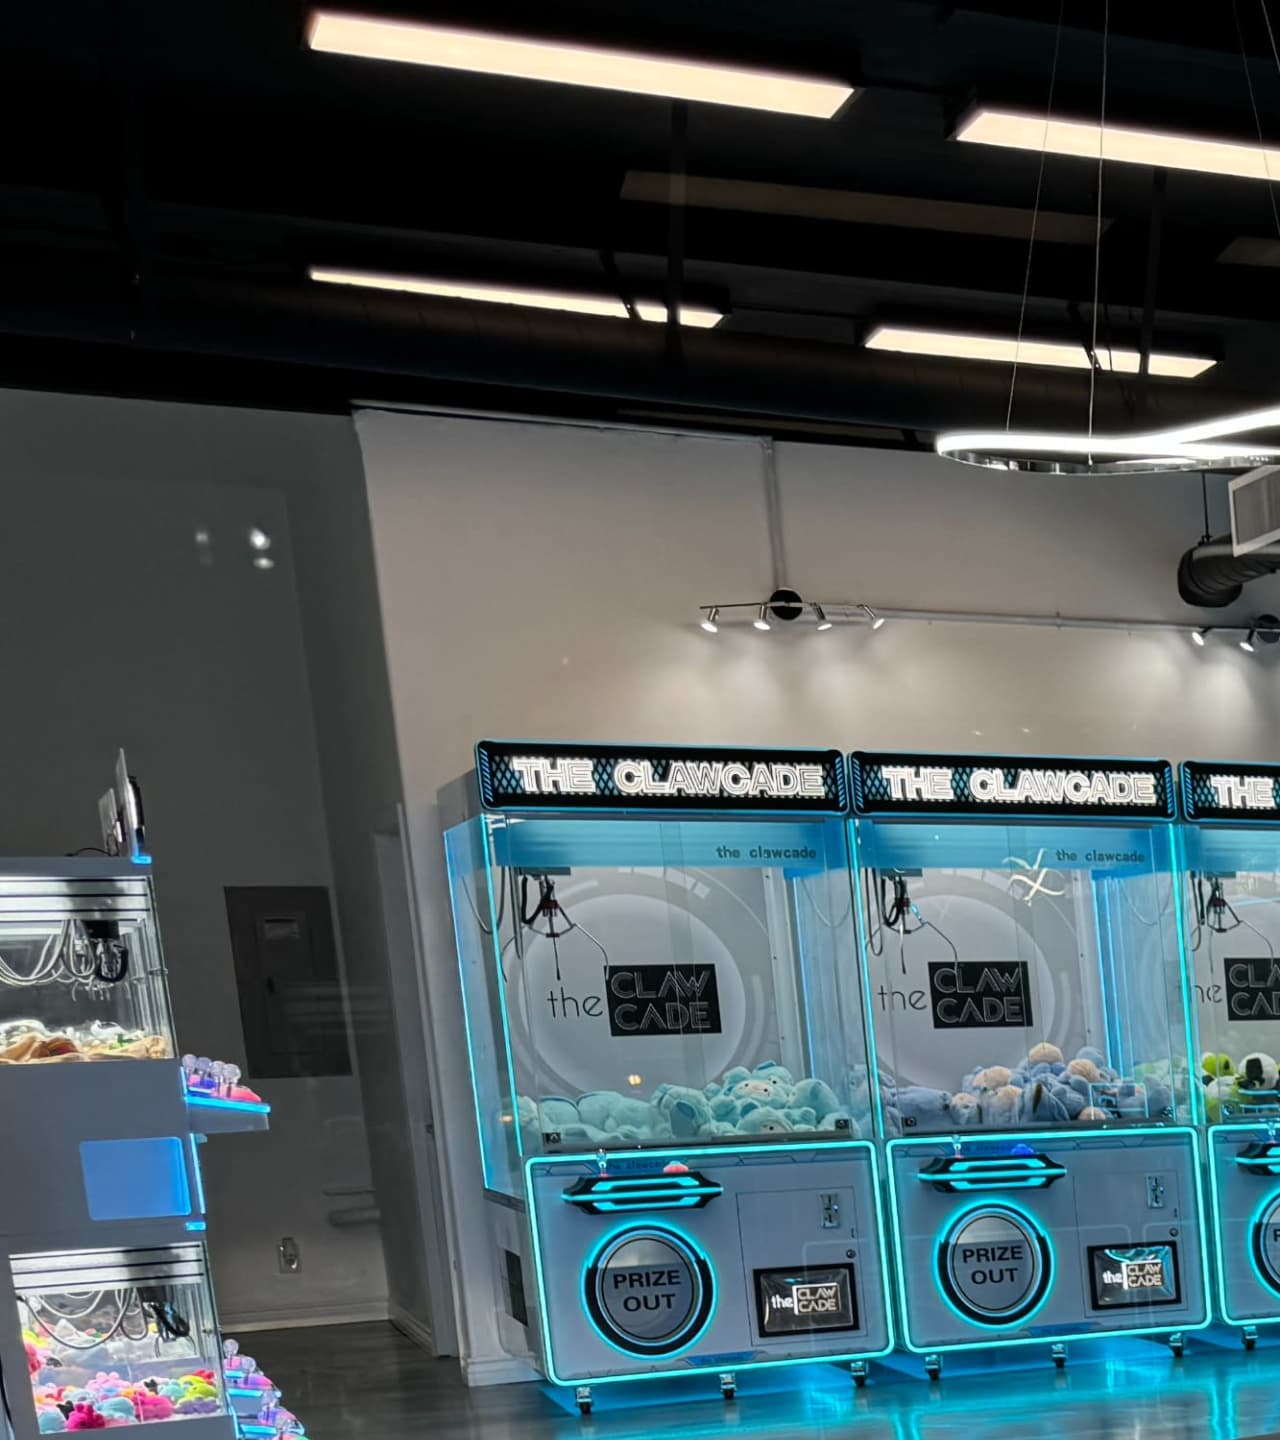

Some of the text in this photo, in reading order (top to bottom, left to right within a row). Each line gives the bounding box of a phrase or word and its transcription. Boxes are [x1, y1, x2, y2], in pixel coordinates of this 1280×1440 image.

[512, 755, 825, 799] THE CLAWCADE
[881, 765, 1157, 805] THE CLAWCADE
[1210, 774, 1274, 808] THE
[717, 845, 817, 860] the clawcade
[1056, 850, 1145, 863] the clawcade
[610, 970, 711, 999] CLAW
[933, 967, 1021, 994] CLAW
[547, 987, 603, 1018] the
[936, 996, 1025, 1024] CADE
[614, 1001, 712, 1031] CADE
[963, 1245, 1024, 1263] PRIZE
[971, 1267, 1018, 1285] OUT
[1103, 1271, 1122, 1285] the
[1127, 1263, 1162, 1276] CLAW
[613, 1270, 681, 1290] PRIZE
[1128, 1275, 1162, 1288] CADE
[772, 1294, 794, 1308] the
[797, 1286, 836, 1300] CLAW
[623, 1294, 676, 1313] OUT
[798, 1299, 837, 1312] CADE
